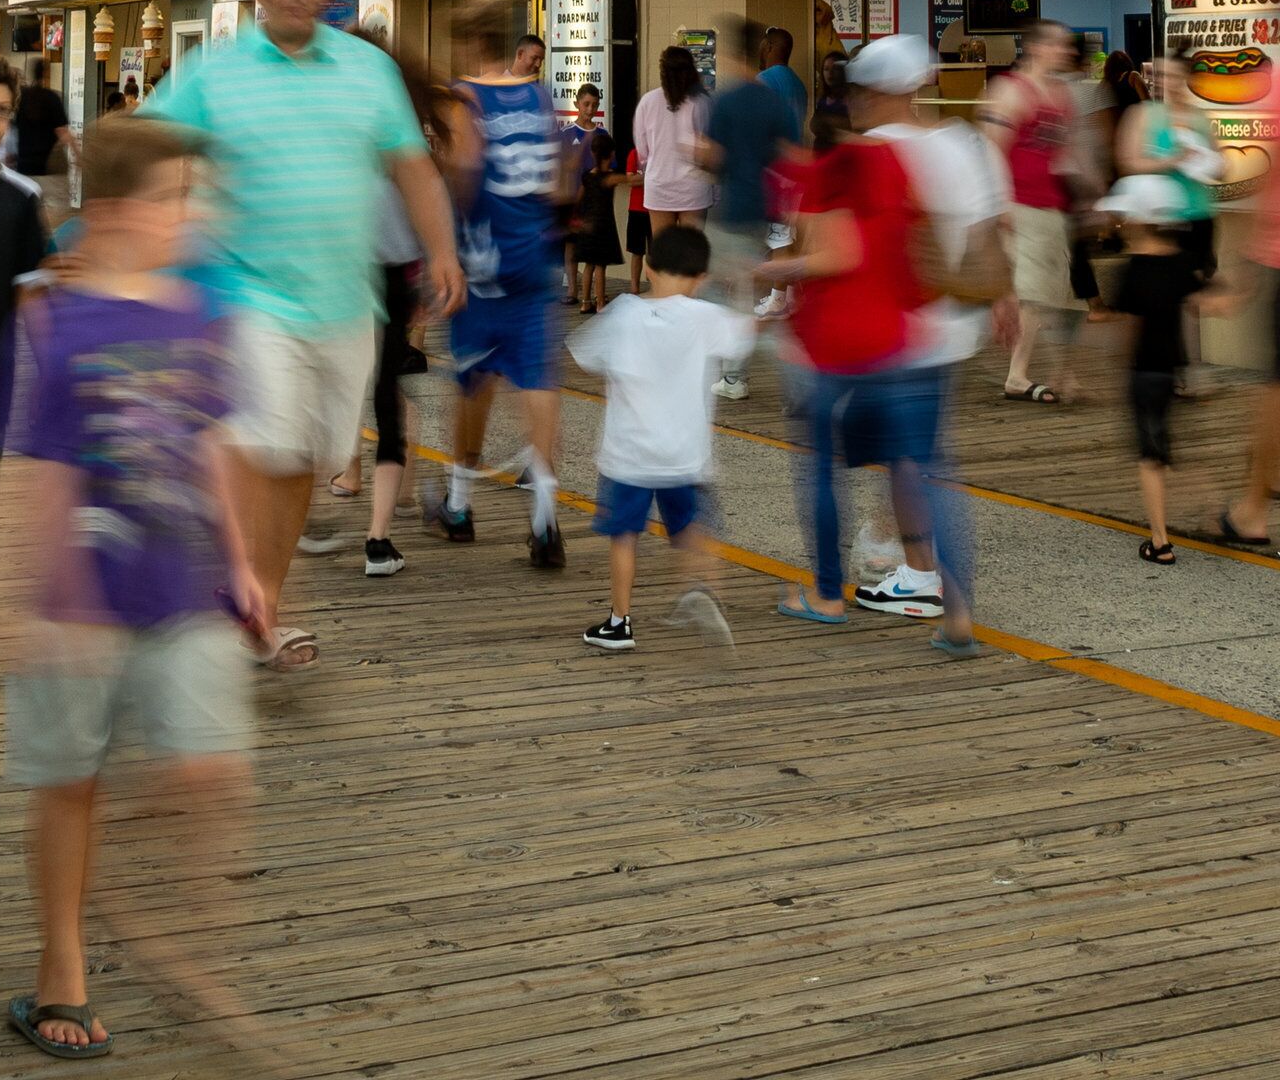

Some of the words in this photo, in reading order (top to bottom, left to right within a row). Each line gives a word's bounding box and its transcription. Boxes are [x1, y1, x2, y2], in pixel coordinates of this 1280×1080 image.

[557, 12, 600, 23] BOARDWALK
[838, 24, 856, 33] Grape
[1167, 20, 1187, 34] HOT
[1187, 20, 1208, 33] DOG
[1209, 19, 1218, 32] &
[1218, 19, 1247, 32] FRIES
[569, 30, 588, 40] MALL
[1220, 32, 1247, 46] SODA
[565, 55, 582, 67] OVER
[555, 72, 576, 83] GREAT
[578, 72, 602, 83] STORES
[553, 88, 559, 99] &
[1210, 119, 1250, 138] Cheese
